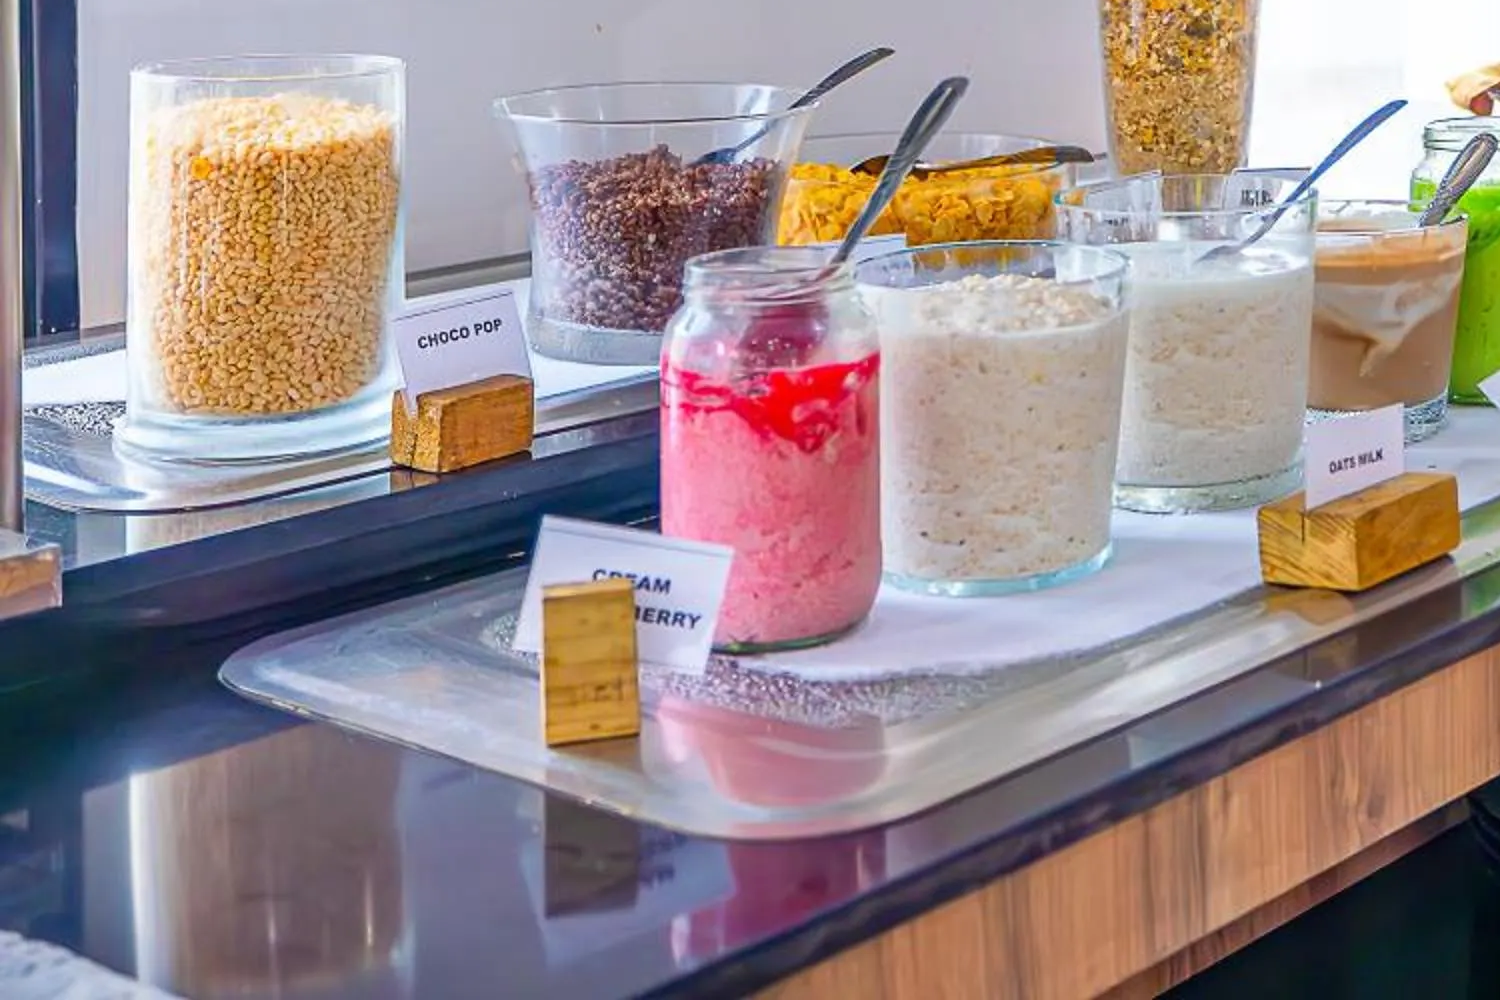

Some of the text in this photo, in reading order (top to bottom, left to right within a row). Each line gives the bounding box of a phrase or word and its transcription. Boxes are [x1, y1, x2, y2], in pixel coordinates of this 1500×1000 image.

[417, 318, 502, 349] CHOCO POP
[1329, 448, 1383, 474] OATS MILK
